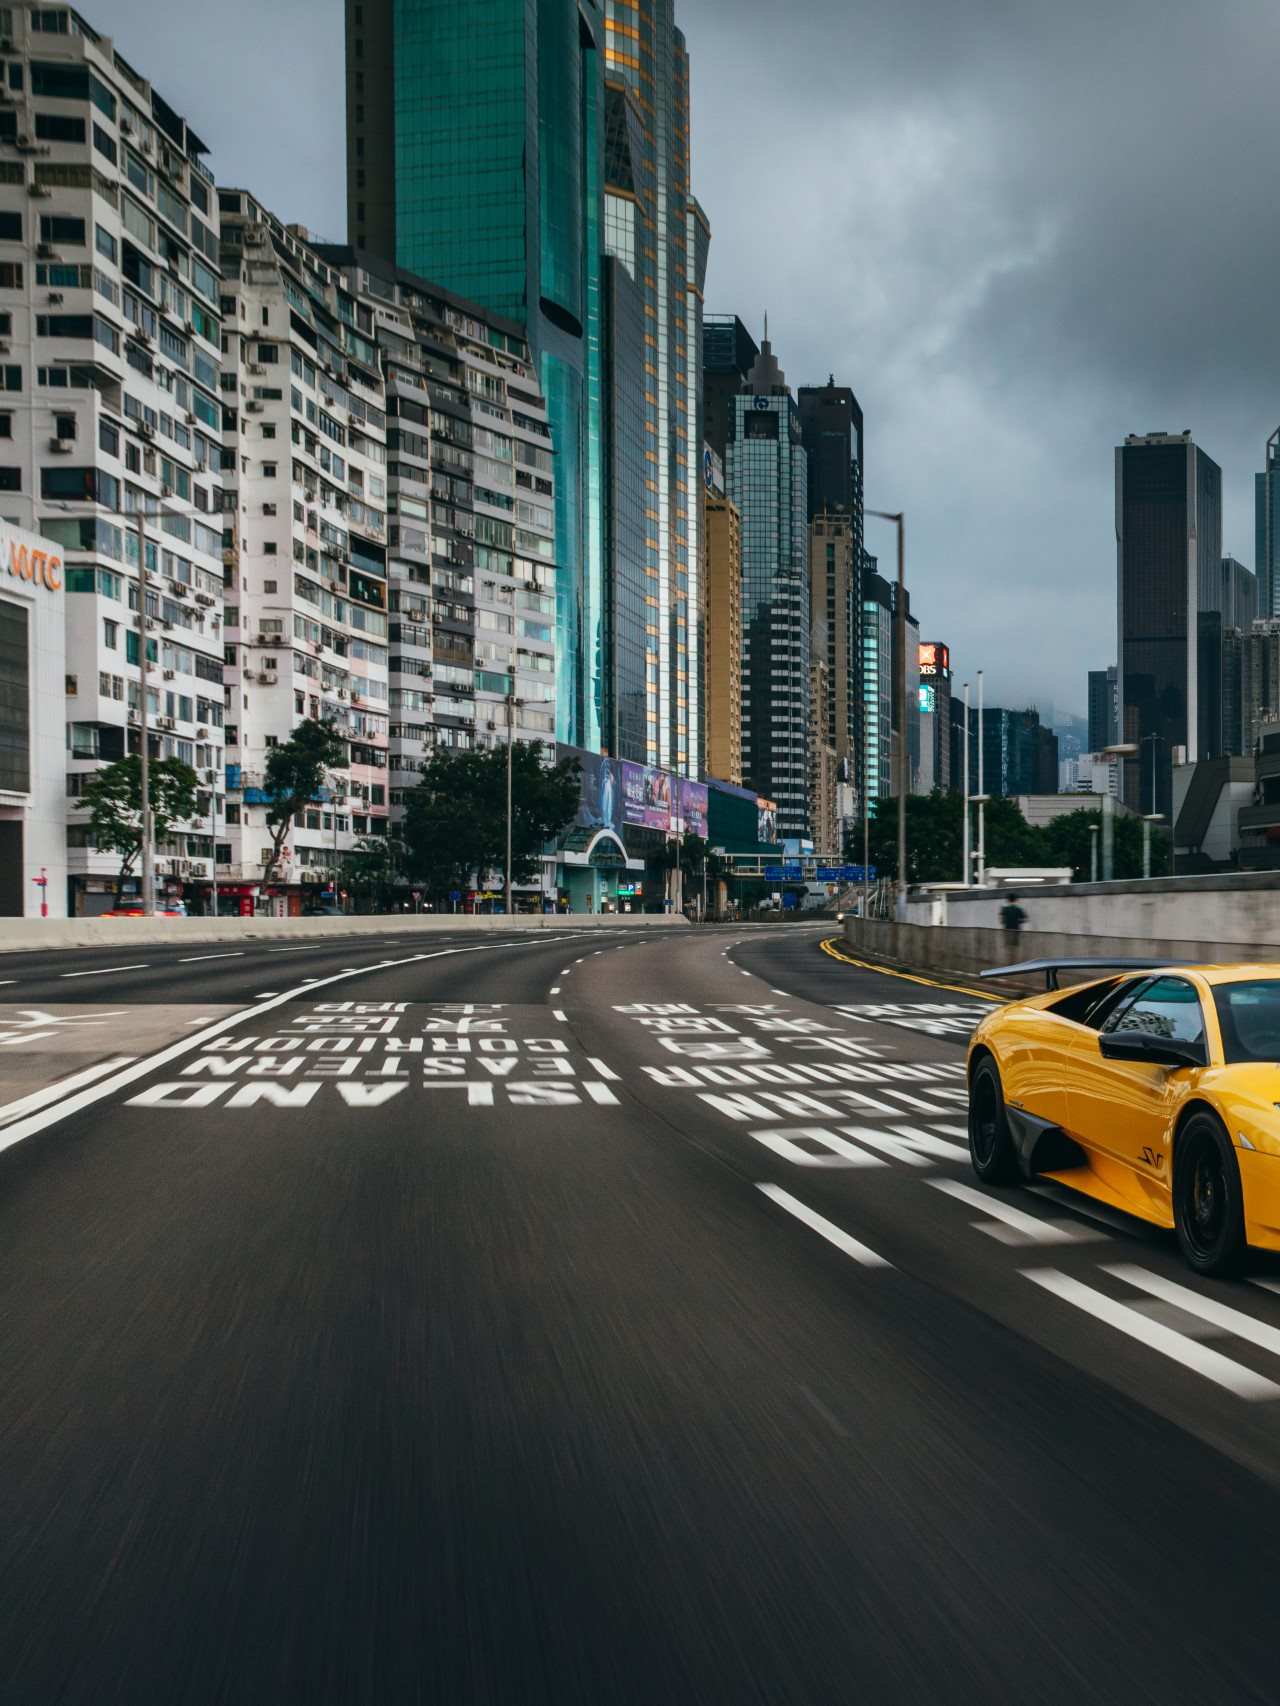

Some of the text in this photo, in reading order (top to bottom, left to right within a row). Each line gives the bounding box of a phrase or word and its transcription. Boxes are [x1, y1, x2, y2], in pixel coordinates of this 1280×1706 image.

[201, 1037, 571, 1053] CORRIDOR
[178, 1056, 577, 1076] EASTERN
[123, 1081, 622, 1107] ISLAND
